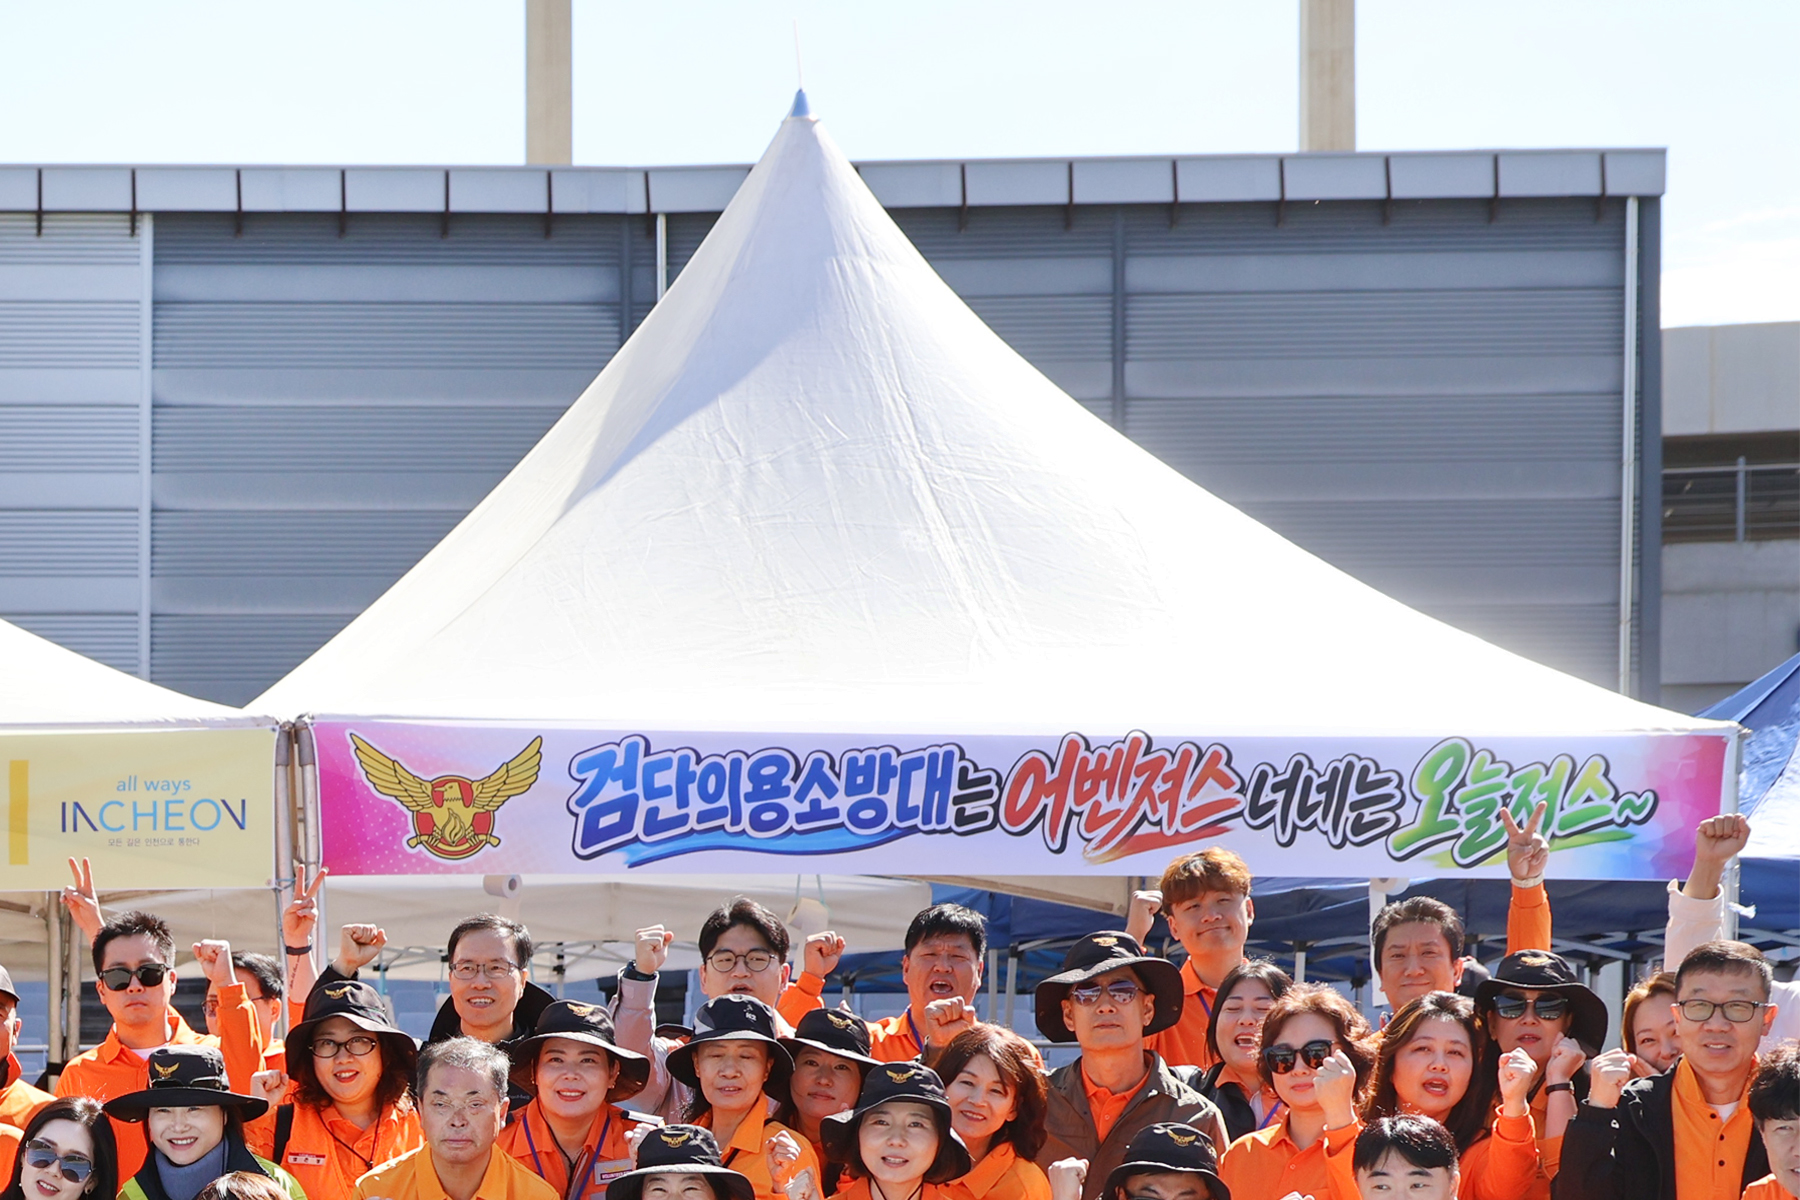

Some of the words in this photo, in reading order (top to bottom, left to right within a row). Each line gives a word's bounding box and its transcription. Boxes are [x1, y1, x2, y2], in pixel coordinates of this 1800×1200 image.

[116, 775, 137, 791] all
[144, 779, 191, 796] ways
[570, 738, 999, 855] 검단의용소방대는
[1001, 735, 1242, 852] 어벤져스
[1246, 757, 1397, 839] 너네는
[61, 798, 246, 832] INCHEON
[108, 838, 122, 847] 모든
[144, 837, 174, 847] 인천으로
